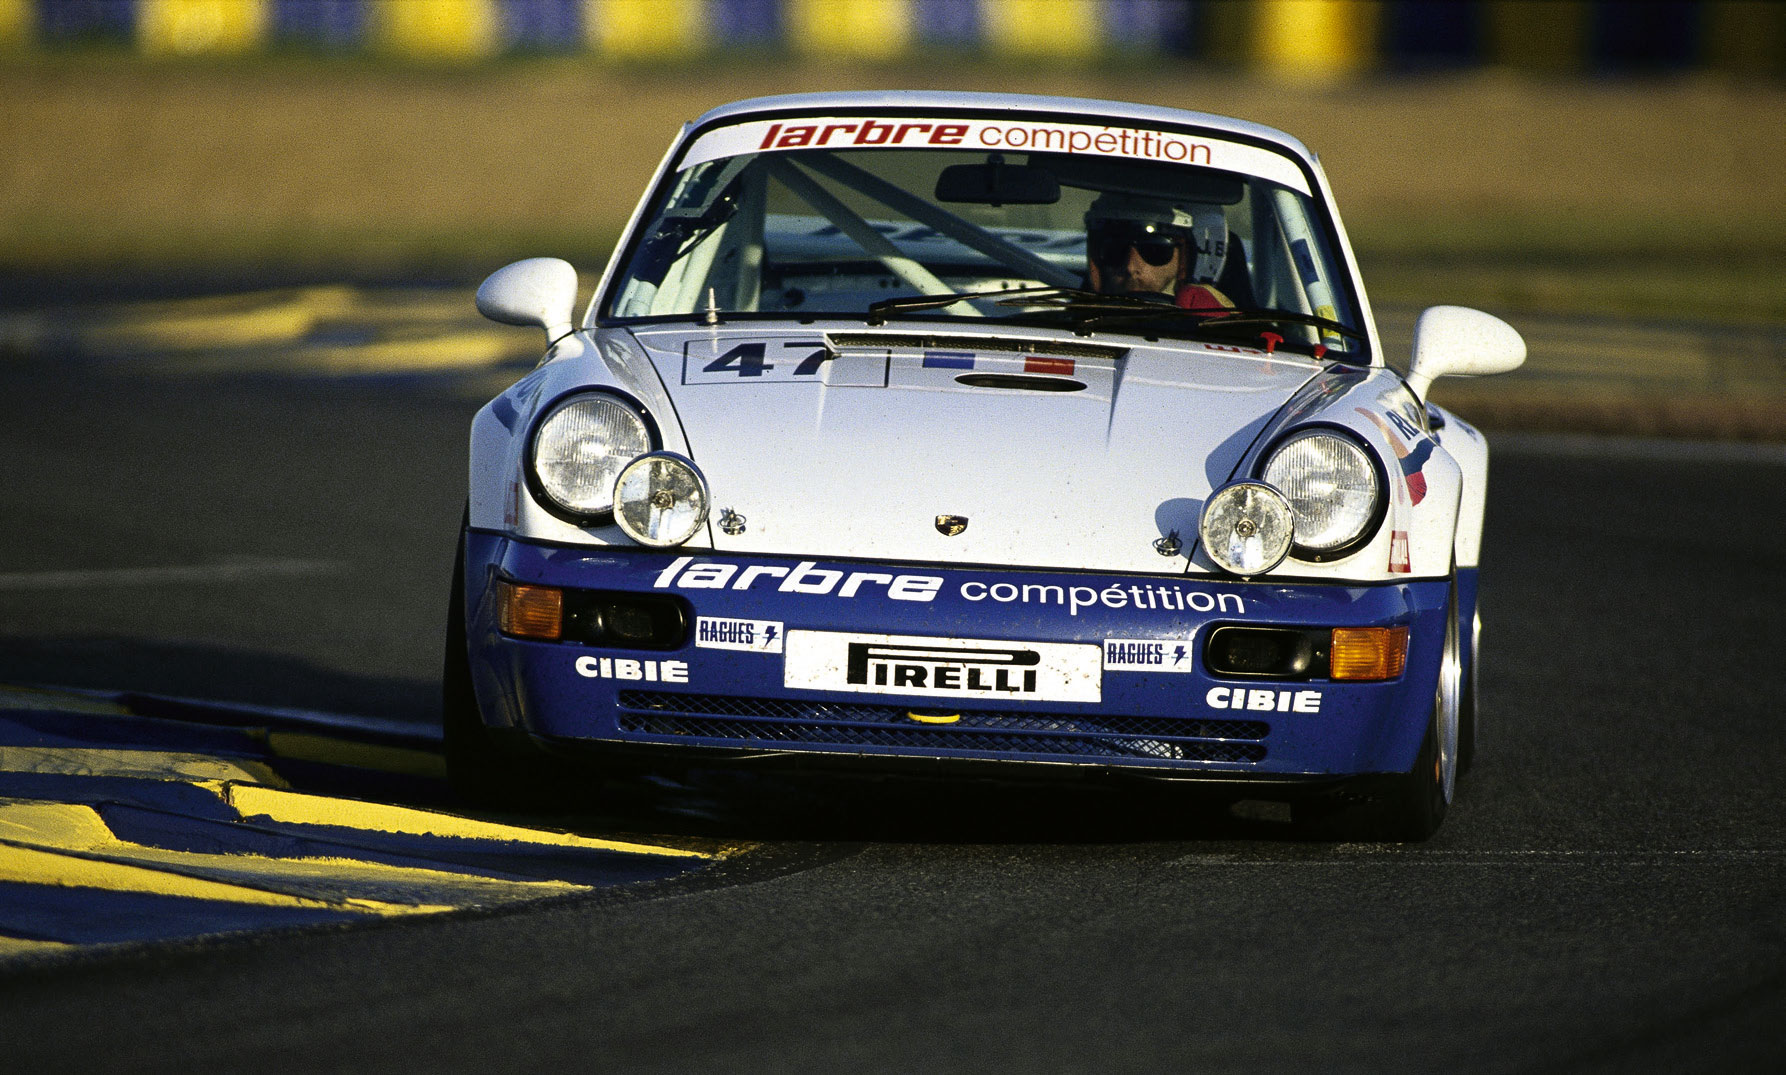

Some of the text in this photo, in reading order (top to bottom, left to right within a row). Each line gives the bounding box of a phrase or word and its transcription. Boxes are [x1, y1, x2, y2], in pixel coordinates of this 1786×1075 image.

[758, 123, 1212, 166] larbre compétition
[703, 342, 834, 378] 47
[653, 556, 1246, 616] larbre compétition
[699, 620, 755, 645] RAGUES
[847, 642, 1041, 693] PIRELLI
[1107, 642, 1163, 665] RAGUES
